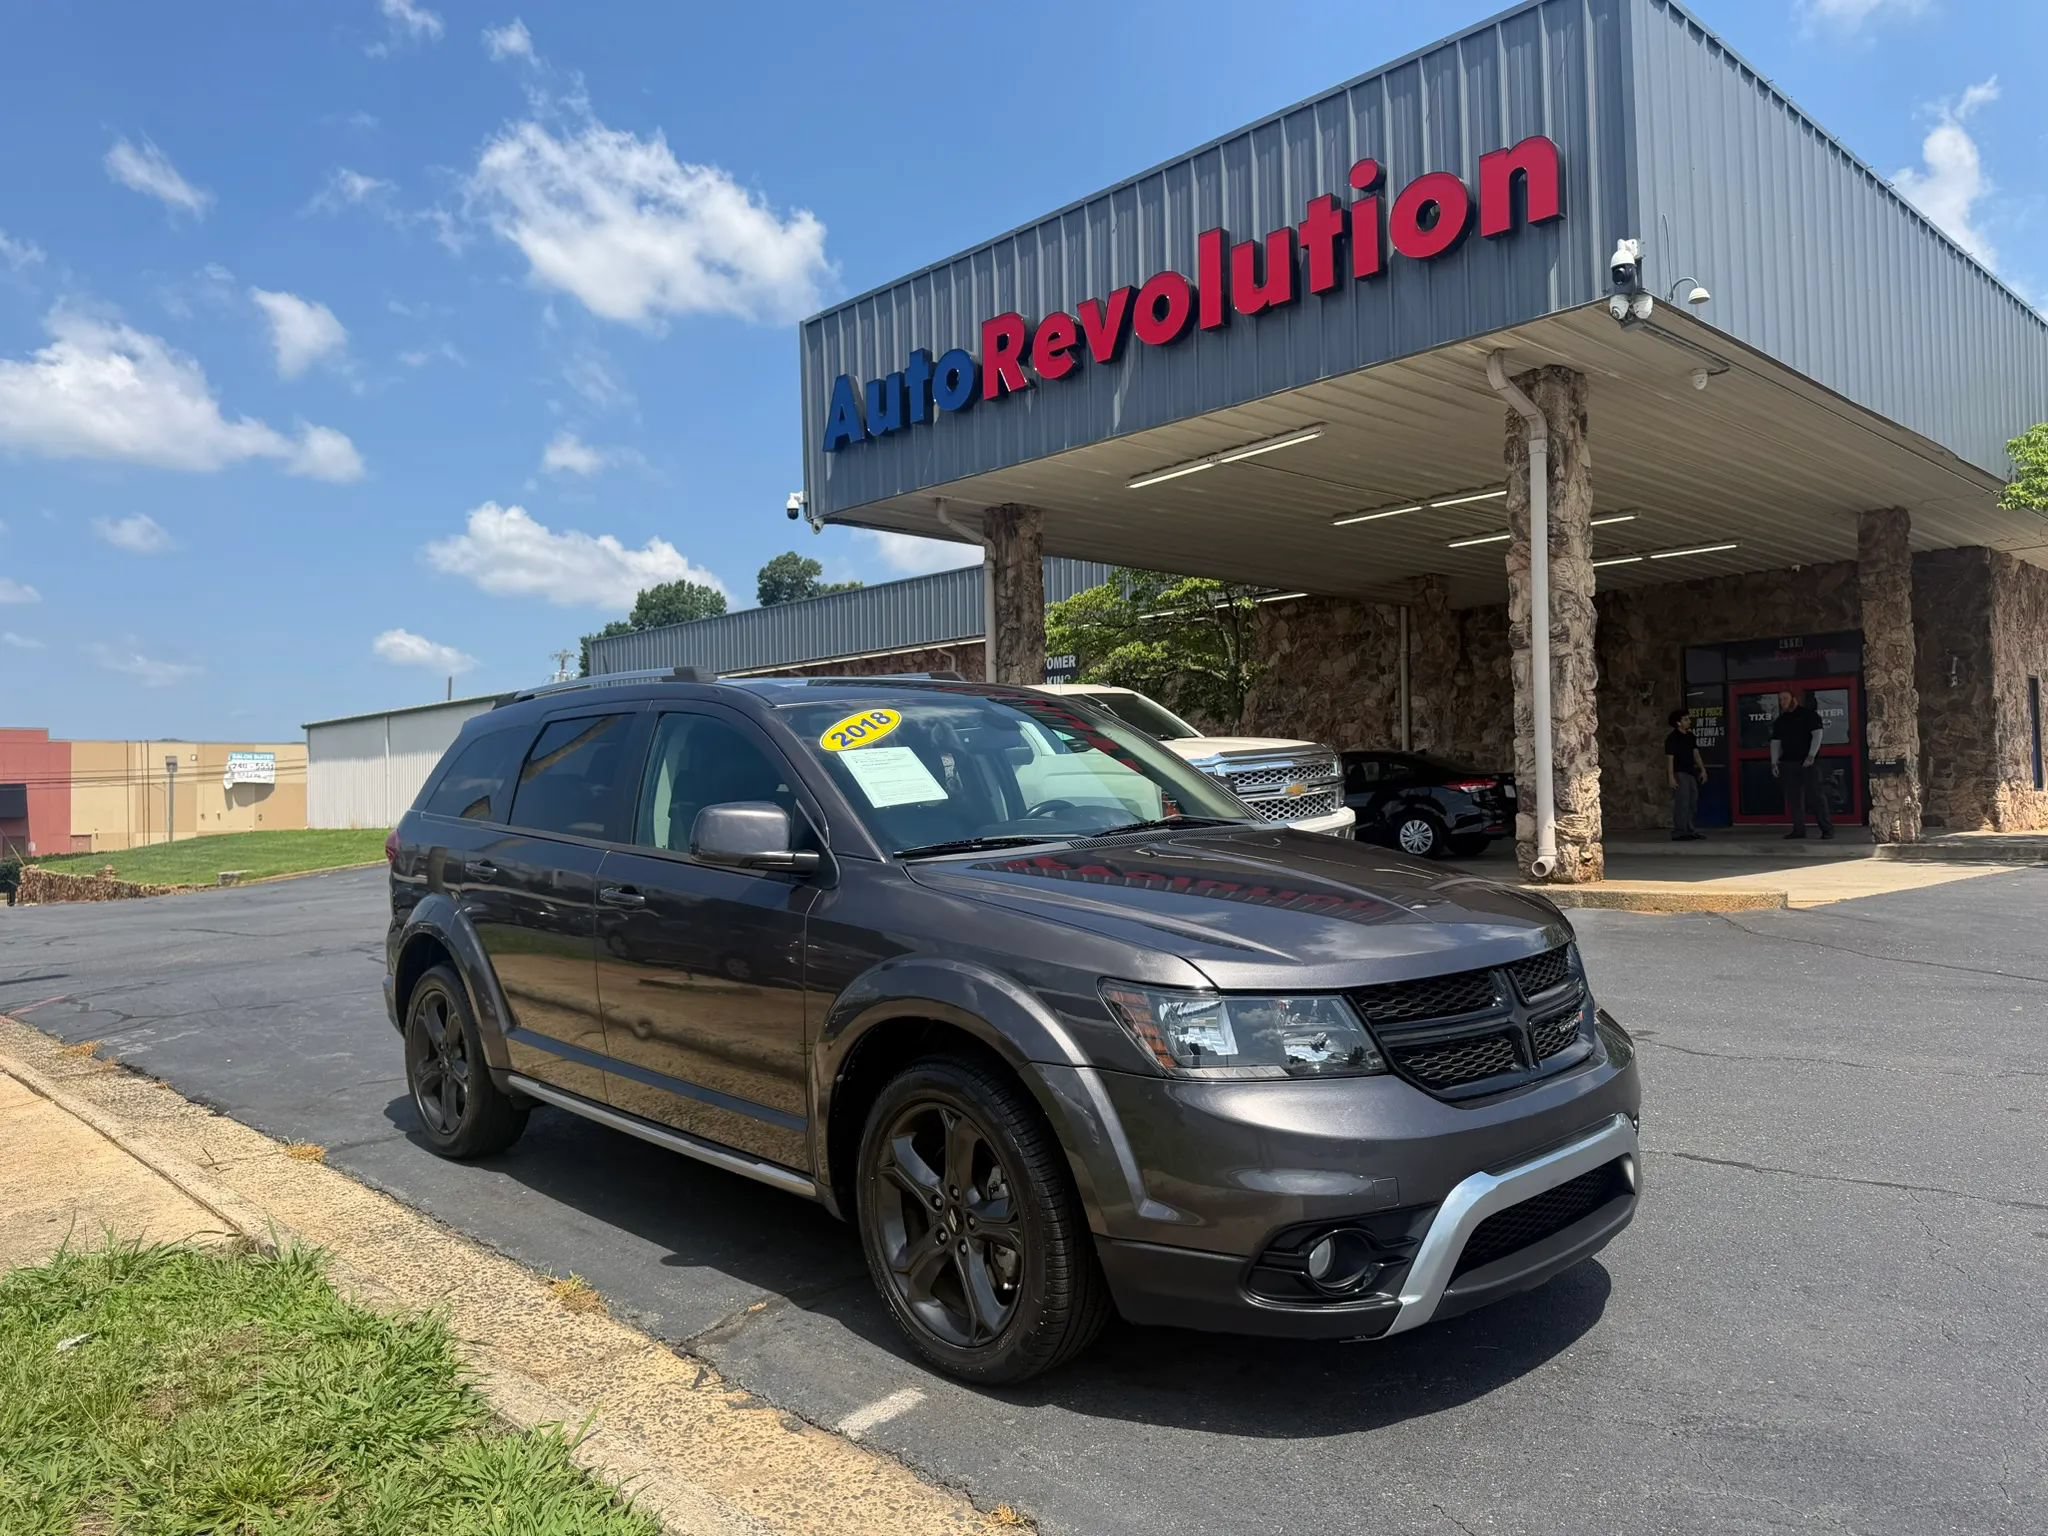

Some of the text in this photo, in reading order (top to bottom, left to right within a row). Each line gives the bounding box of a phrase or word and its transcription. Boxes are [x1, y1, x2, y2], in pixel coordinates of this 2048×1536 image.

[1817, 708, 1844, 718] NTER
[1696, 717, 1718, 728] IN THE
[830, 711, 892, 748] 2018
